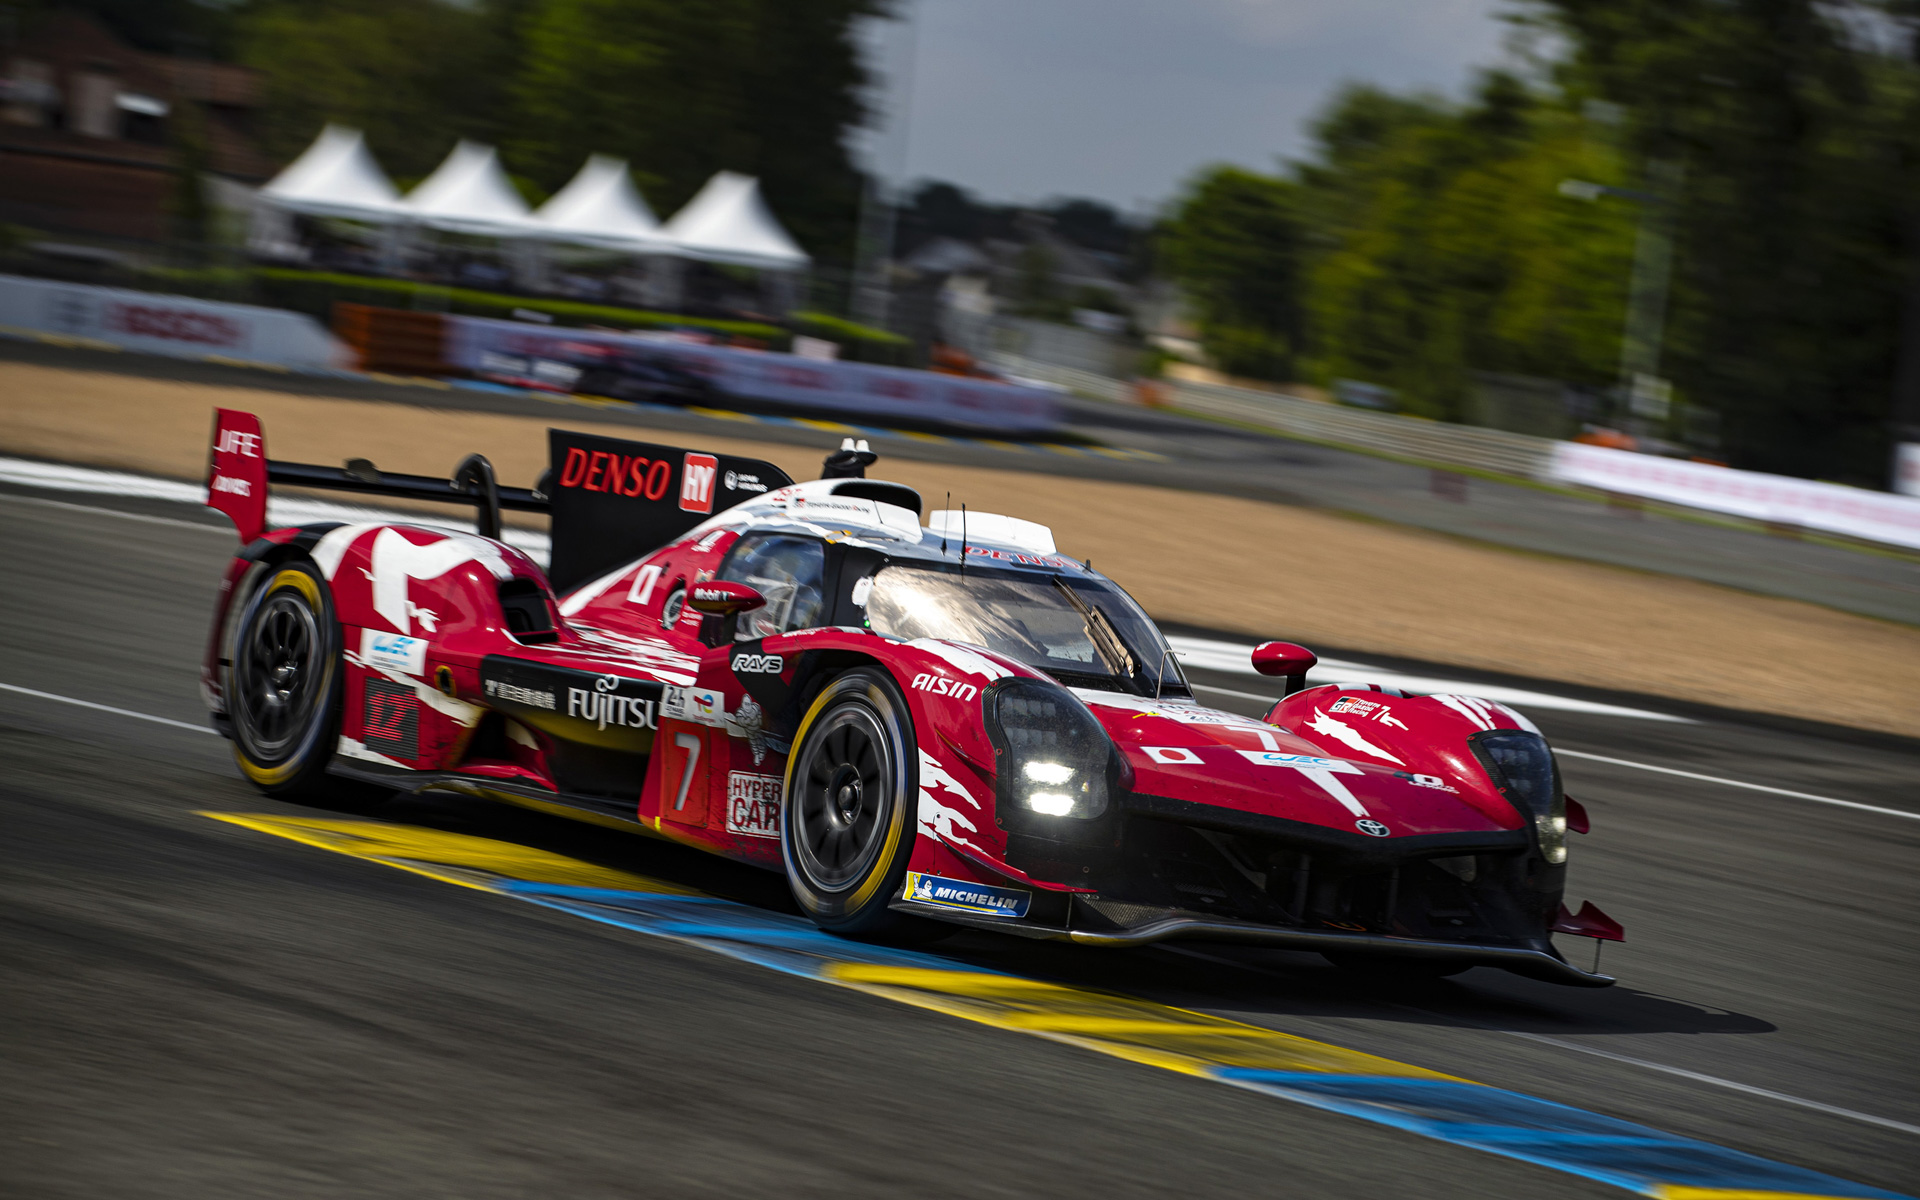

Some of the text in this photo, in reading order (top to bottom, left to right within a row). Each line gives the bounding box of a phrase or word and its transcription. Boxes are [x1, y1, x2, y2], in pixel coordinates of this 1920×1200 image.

[559, 446, 672, 501] DENSO
[682, 463, 716, 503] HY
[965, 545, 1080, 569] DENSO
[694, 588, 719, 601] Mobil
[732, 654, 783, 673] RAYS
[911, 672, 977, 702] AISIN
[673, 732, 702, 811] 7
[1263, 754, 1330, 766] WEC
[733, 778, 781, 802] HYPER
[733, 797, 780, 832] CAR
[935, 887, 1018, 909] MICHELIN
